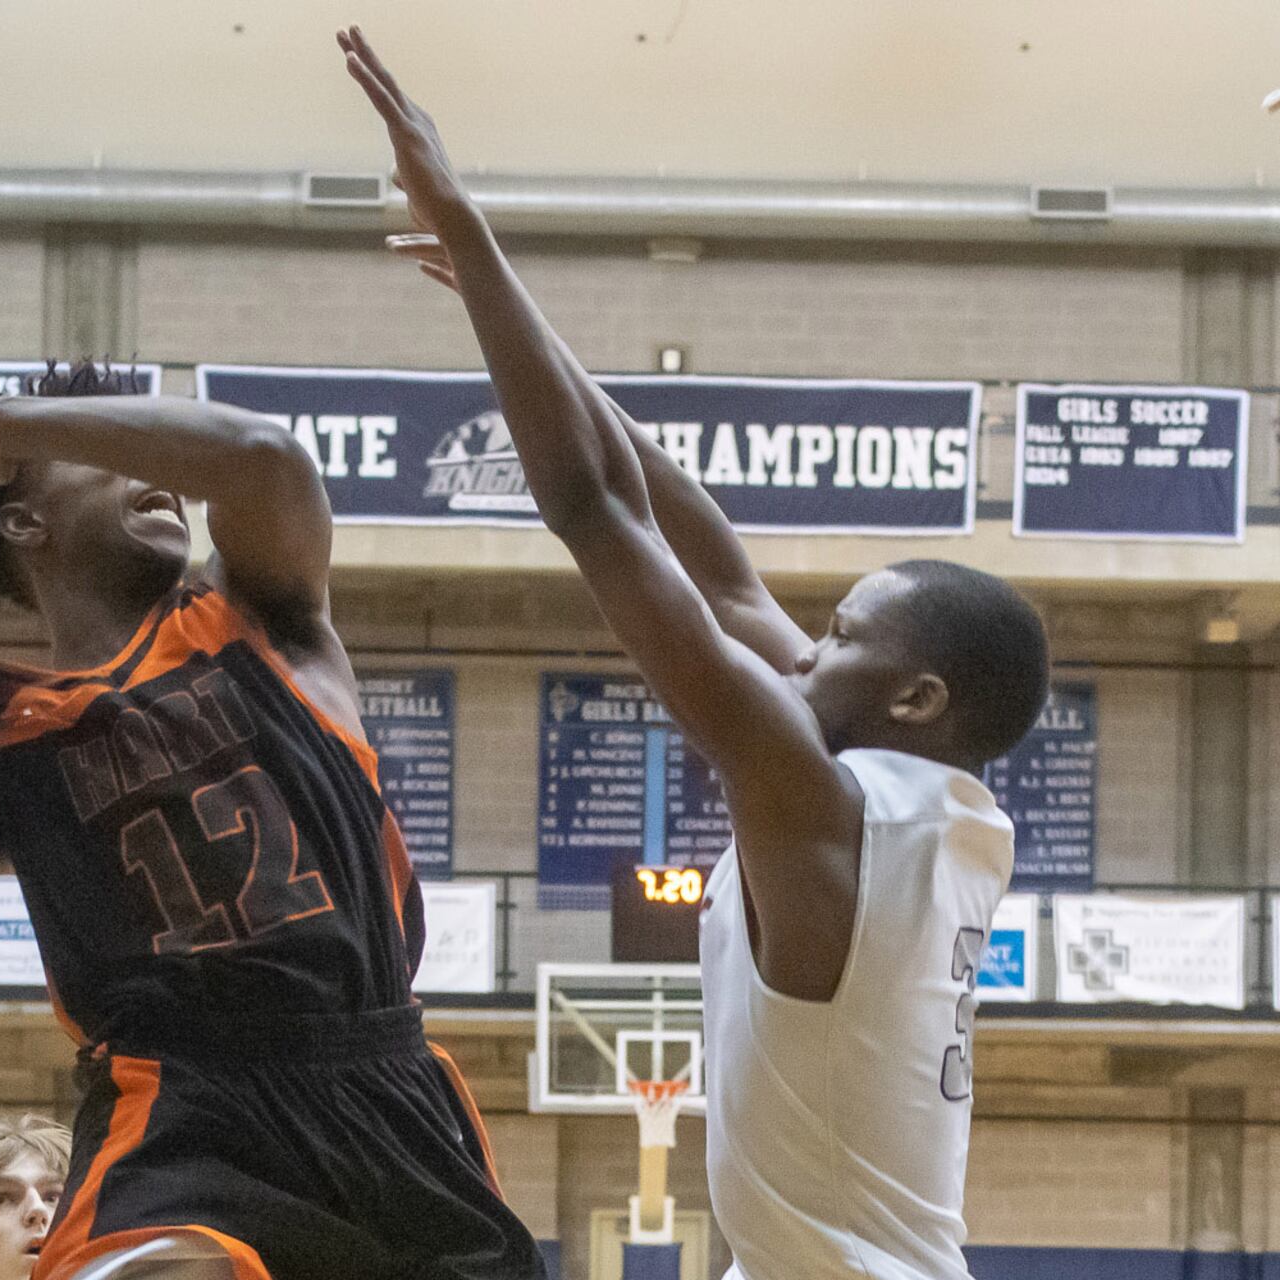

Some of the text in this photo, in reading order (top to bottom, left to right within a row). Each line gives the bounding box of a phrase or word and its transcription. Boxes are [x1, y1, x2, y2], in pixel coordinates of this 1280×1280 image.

[1058, 398, 1209, 425] GIRLS SOCCER
[121, 764, 336, 956] 12
